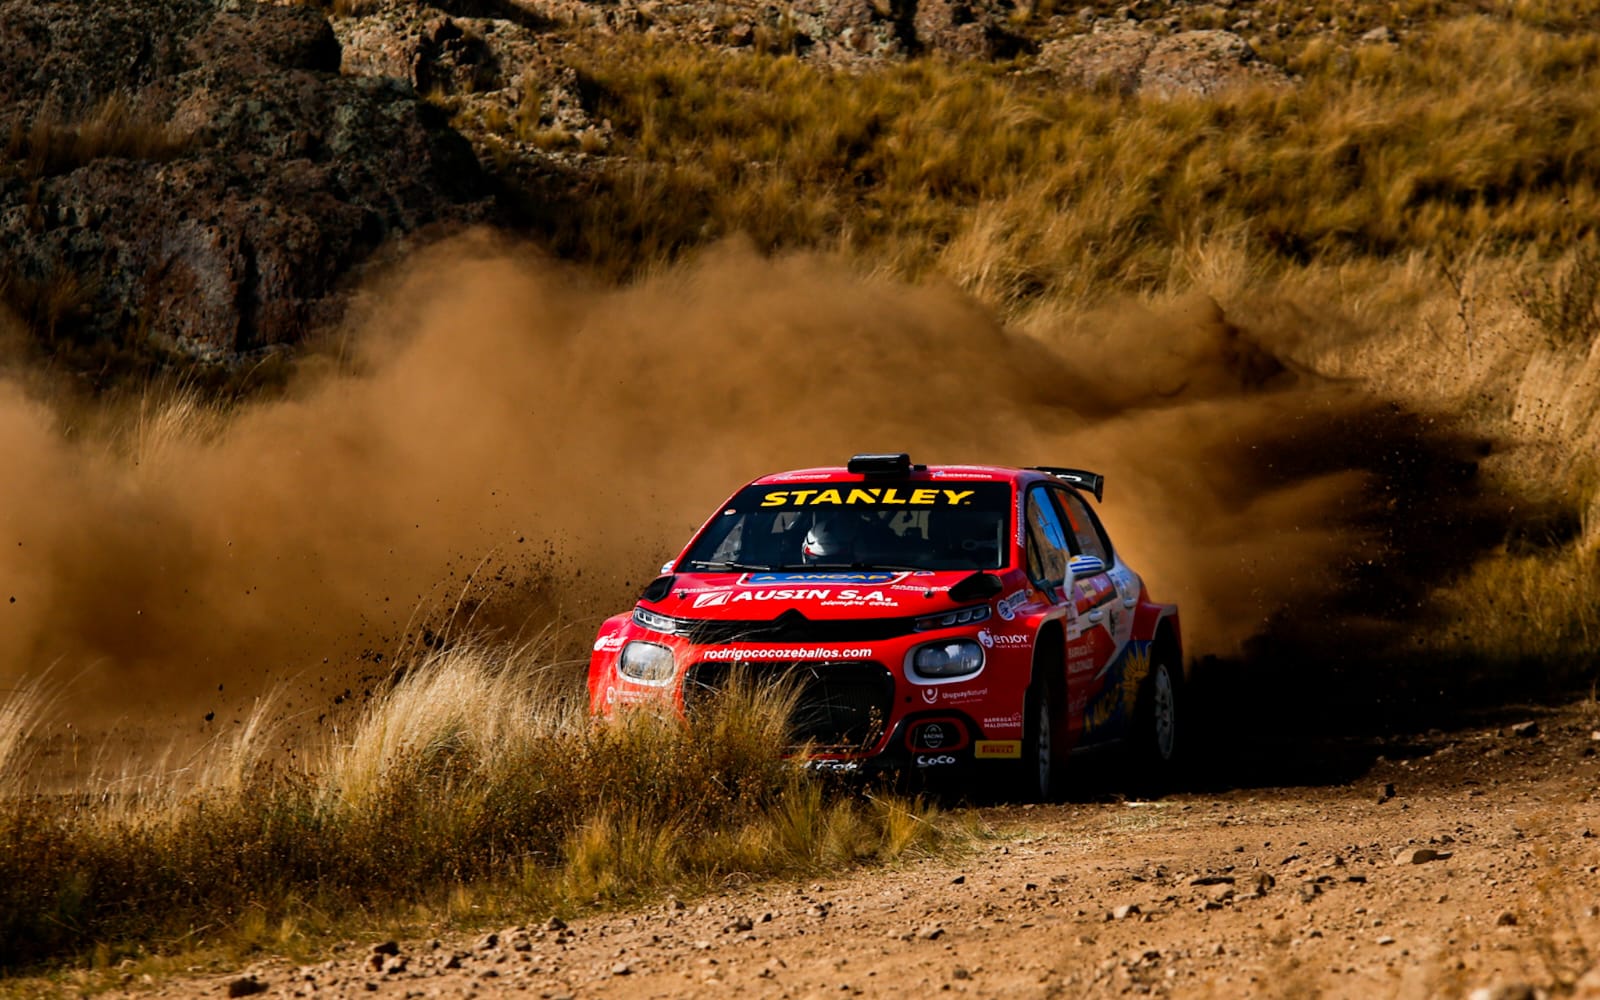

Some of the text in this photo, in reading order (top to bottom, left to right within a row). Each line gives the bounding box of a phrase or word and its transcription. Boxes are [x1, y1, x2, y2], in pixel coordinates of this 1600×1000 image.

[760, 488, 975, 507] STANLEY
[731, 589, 831, 602] AUSIN
[836, 589, 893, 602] S.A.
[703, 647, 872, 660] rodrigococozeballos.com
